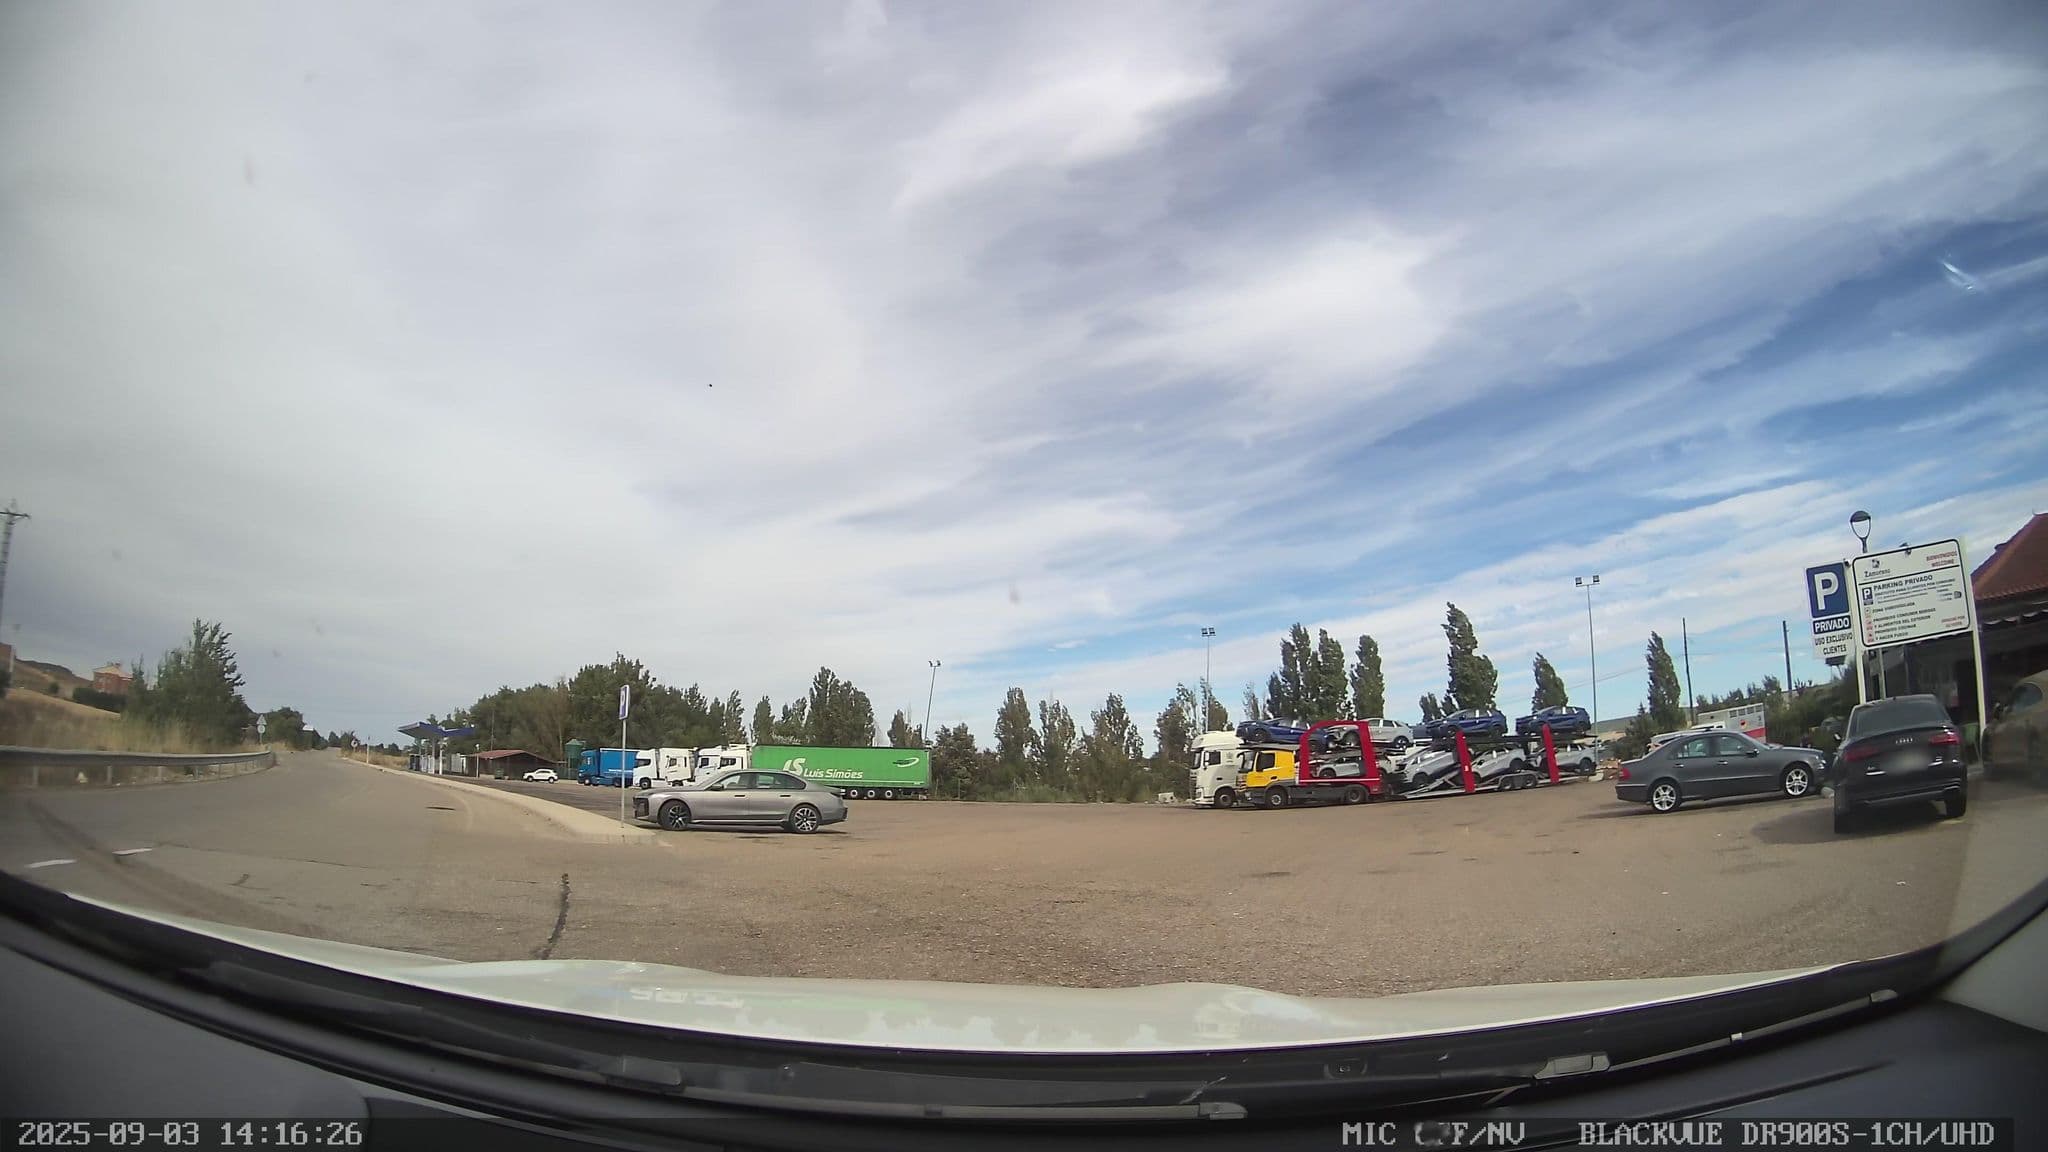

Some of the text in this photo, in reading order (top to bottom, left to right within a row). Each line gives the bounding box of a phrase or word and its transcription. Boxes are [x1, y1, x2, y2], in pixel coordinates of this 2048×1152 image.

[1873, 580, 1904, 590] PARKING
[1904, 575, 1933, 585] PRIVADO
[1814, 571, 1839, 610] P
[1863, 588, 1871, 599] P
[1815, 617, 1849, 632] PRIVADO
[1815, 632, 1852, 645] USO EXCLUSIVO
[1823, 644, 1847, 655] CLIENTES
[803, 768, 863, 779] Luis Simões
